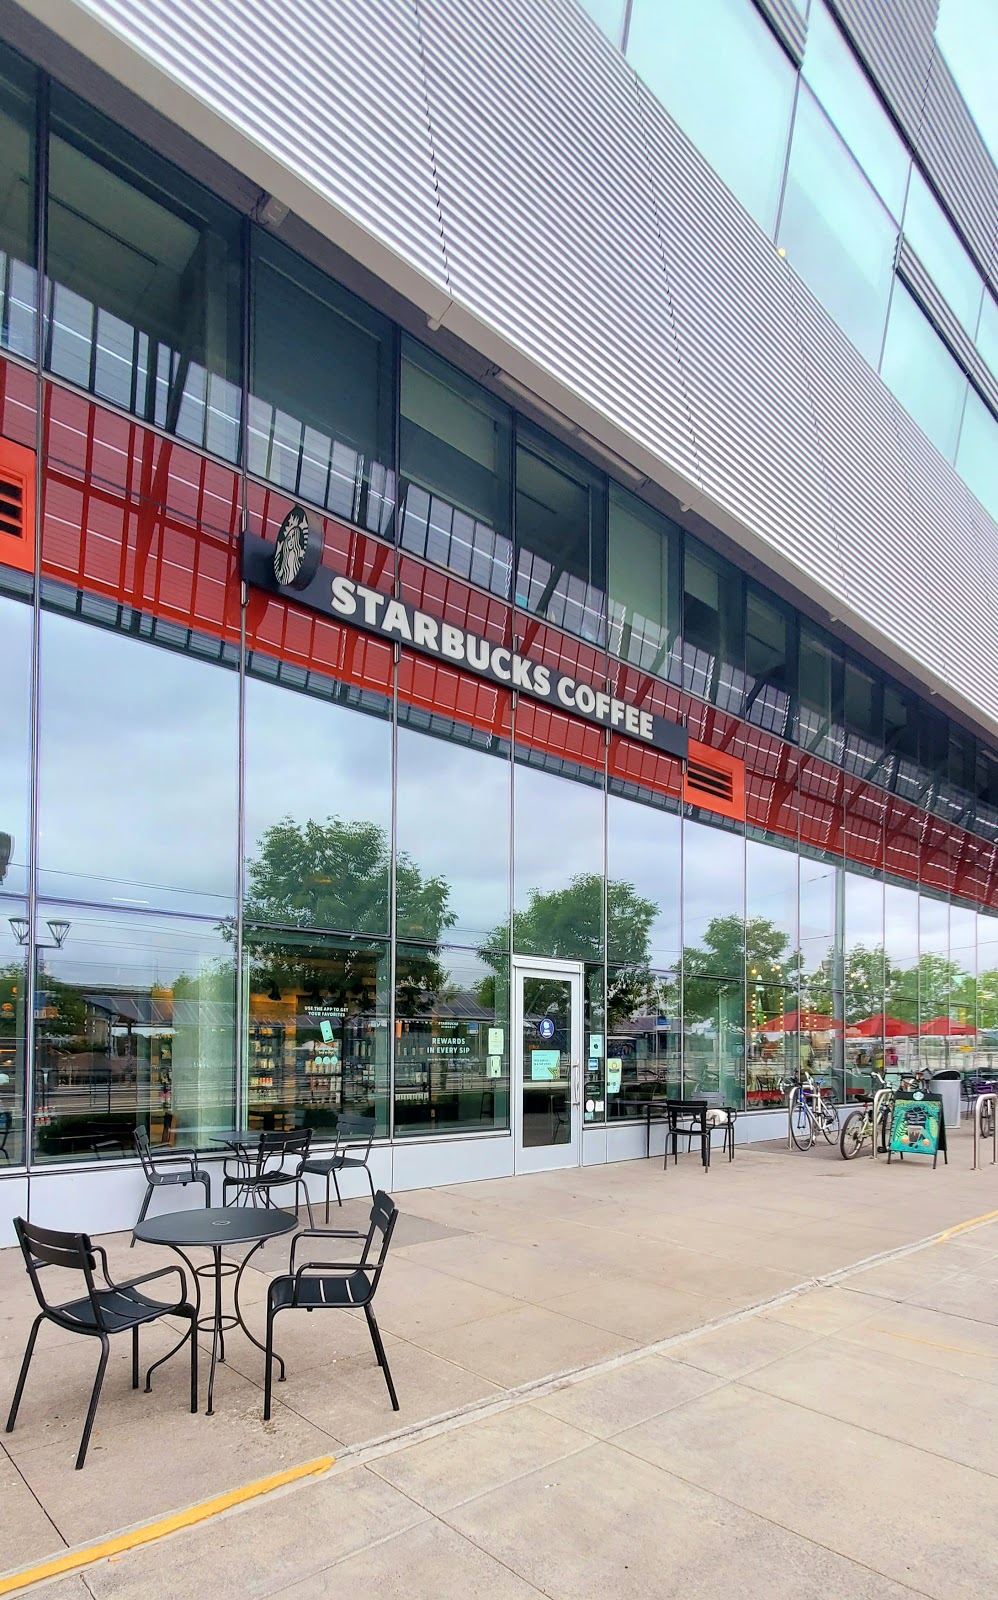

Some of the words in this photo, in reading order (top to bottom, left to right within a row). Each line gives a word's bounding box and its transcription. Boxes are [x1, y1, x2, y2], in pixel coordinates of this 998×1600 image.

[331, 576, 551, 696] STARBUCKS
[557, 676, 654, 740] COFFEE
[431, 1037, 466, 1045] REWARDS
[426, 1046, 435, 1054] IN
[437, 1046, 458, 1054] EVERY
[459, 1046, 470, 1054] SIP
